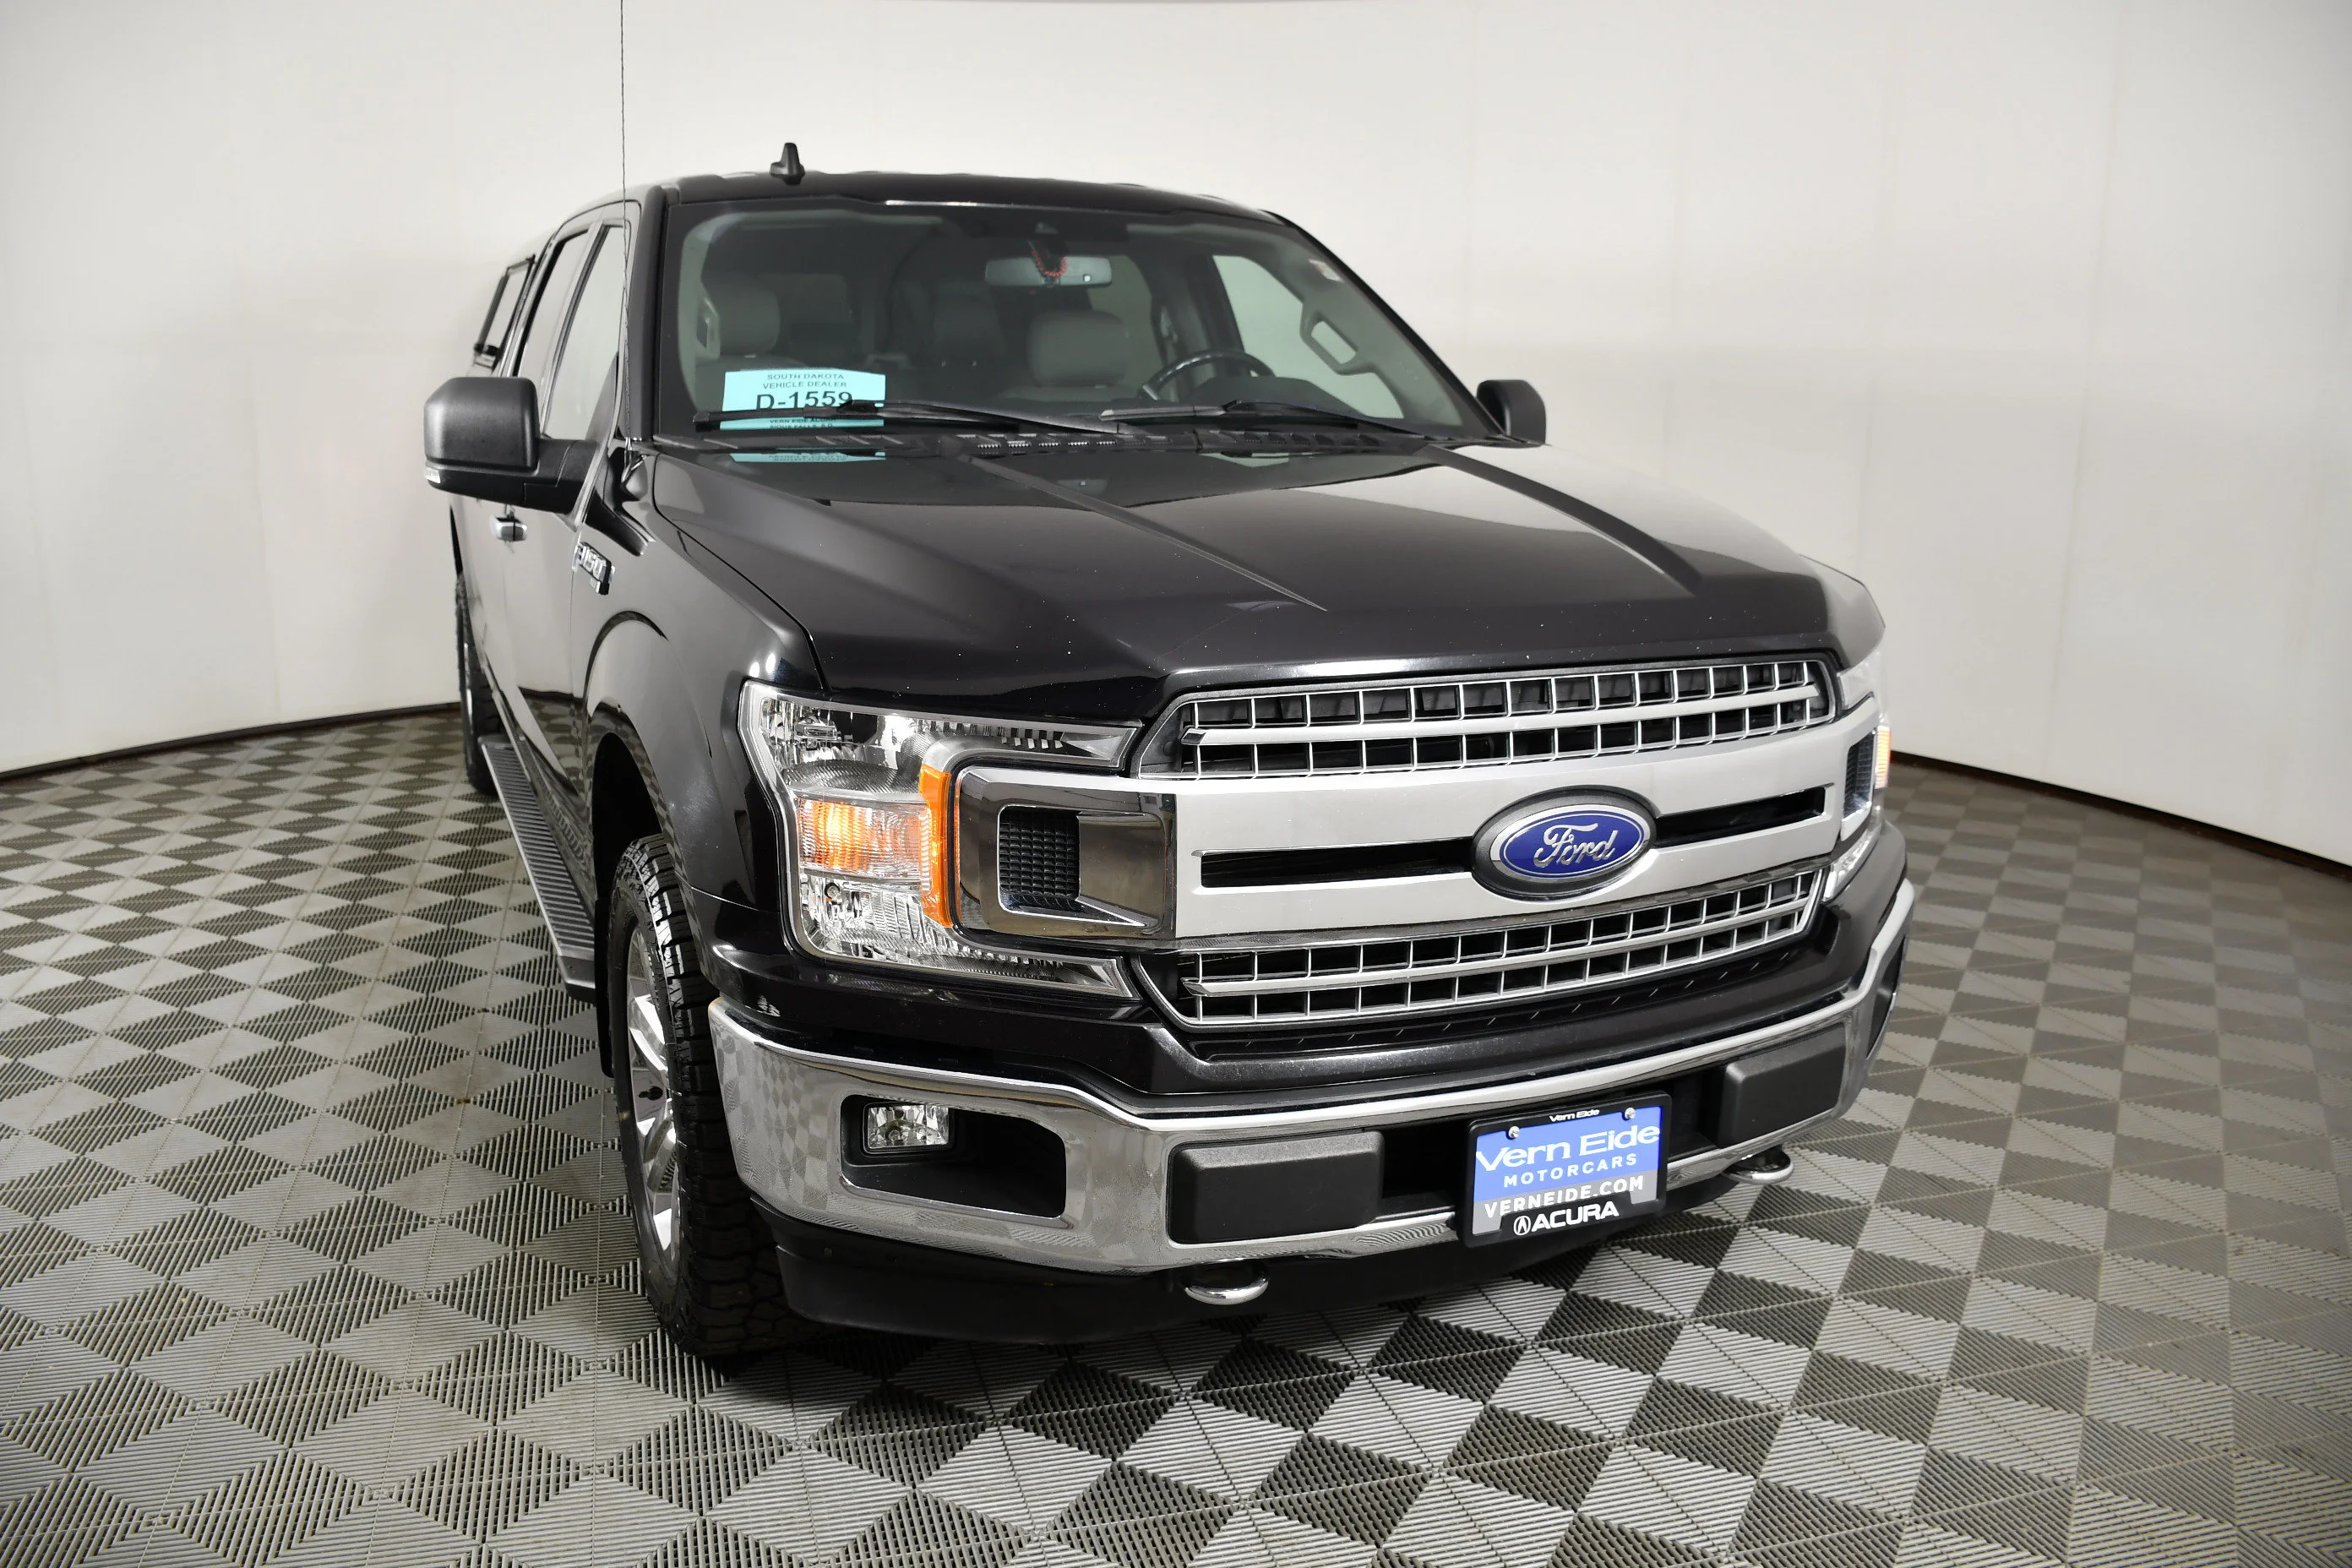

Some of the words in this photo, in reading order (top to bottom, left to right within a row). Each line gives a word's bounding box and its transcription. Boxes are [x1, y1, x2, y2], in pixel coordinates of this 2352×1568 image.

[756, 390, 852, 410] D-1559
[1533, 822, 1619, 868] Ford
[1549, 1112, 1575, 1122] Vern
[1575, 1108, 1600, 1119] Eide
[1476, 1141, 1571, 1172] Vern
[1578, 1124, 1660, 1157] Eide
[1503, 1153, 1637, 1188] MOTORCARS
[1484, 1174, 1644, 1218] VERNEIDE.COM
[1531, 1200, 1620, 1233] ACURA
